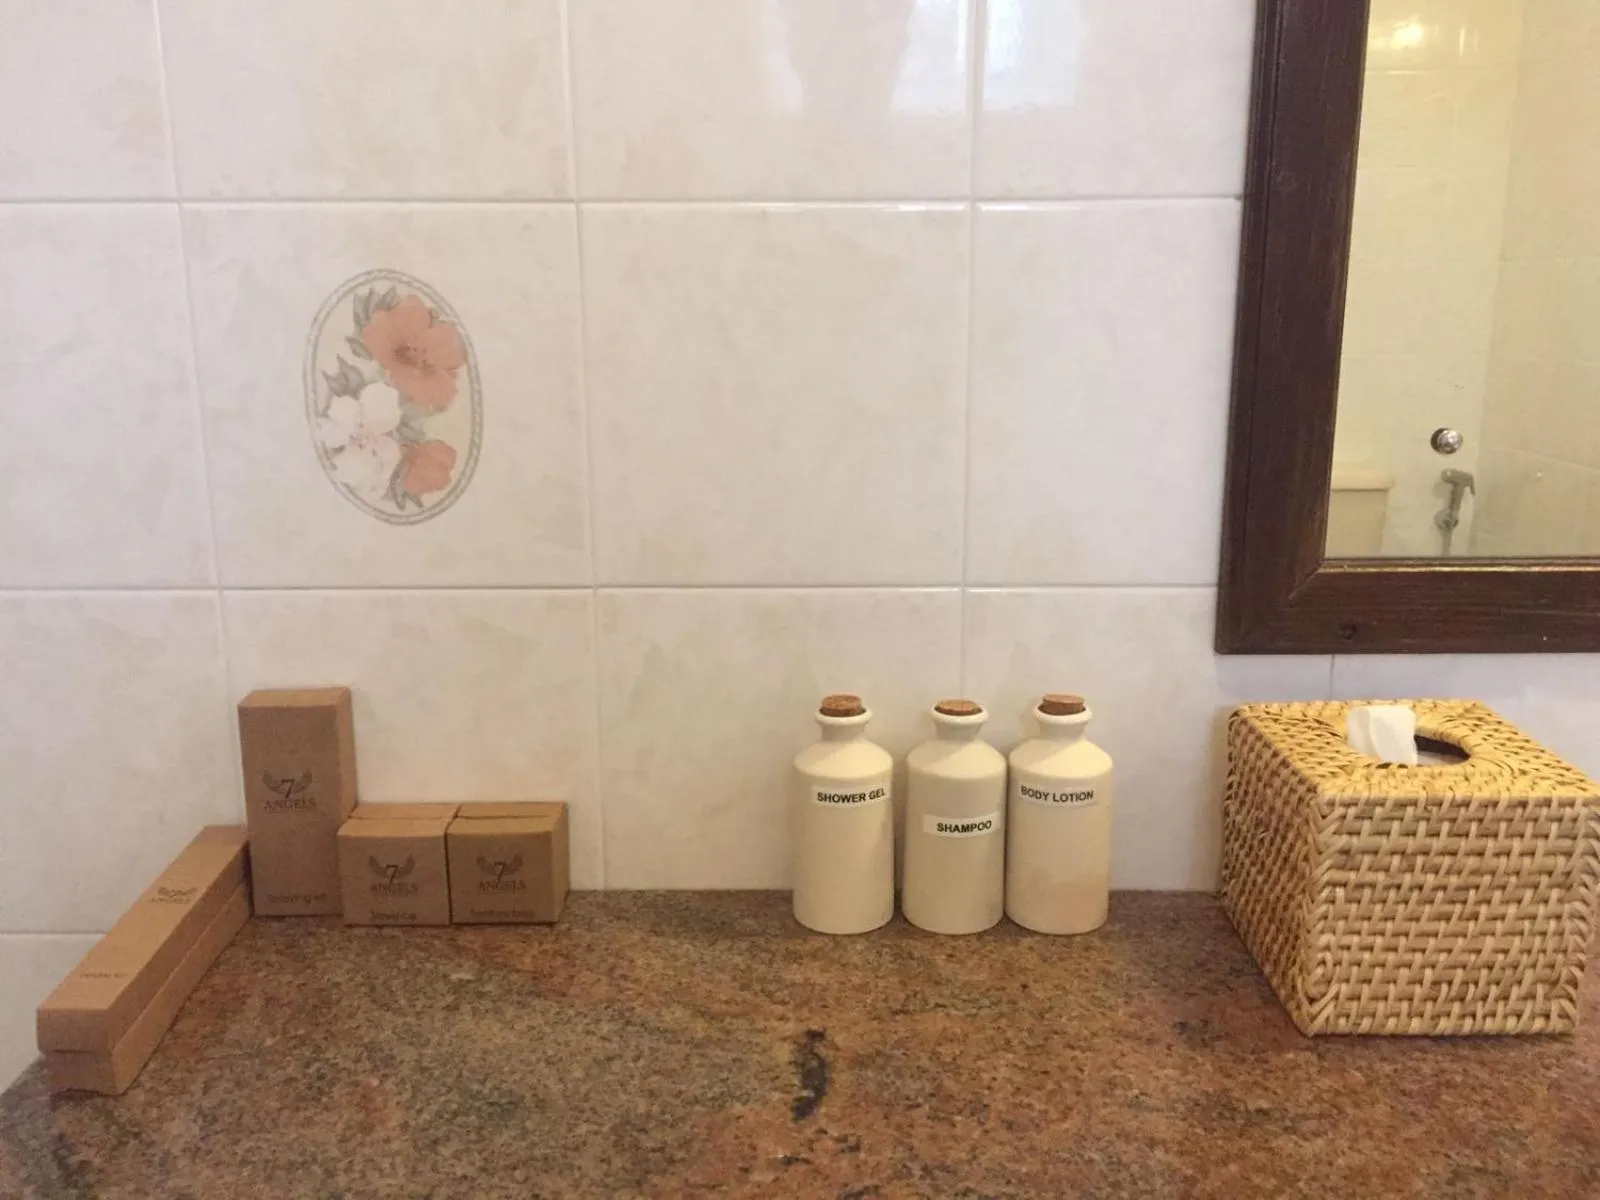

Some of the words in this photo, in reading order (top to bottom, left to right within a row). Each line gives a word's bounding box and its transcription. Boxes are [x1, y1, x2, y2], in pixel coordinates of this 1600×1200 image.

[281, 778, 296, 799] 7
[817, 791, 866, 803] SHOWER
[868, 787, 885, 800] GEL
[1020, 785, 1049, 801] BODY
[1052, 789, 1094, 802] LOTION
[264, 798, 316, 811] ANGELS
[937, 820, 992, 833] SHAMPOO
[386, 864, 399, 891] 7
[494, 861, 506, 888] 7
